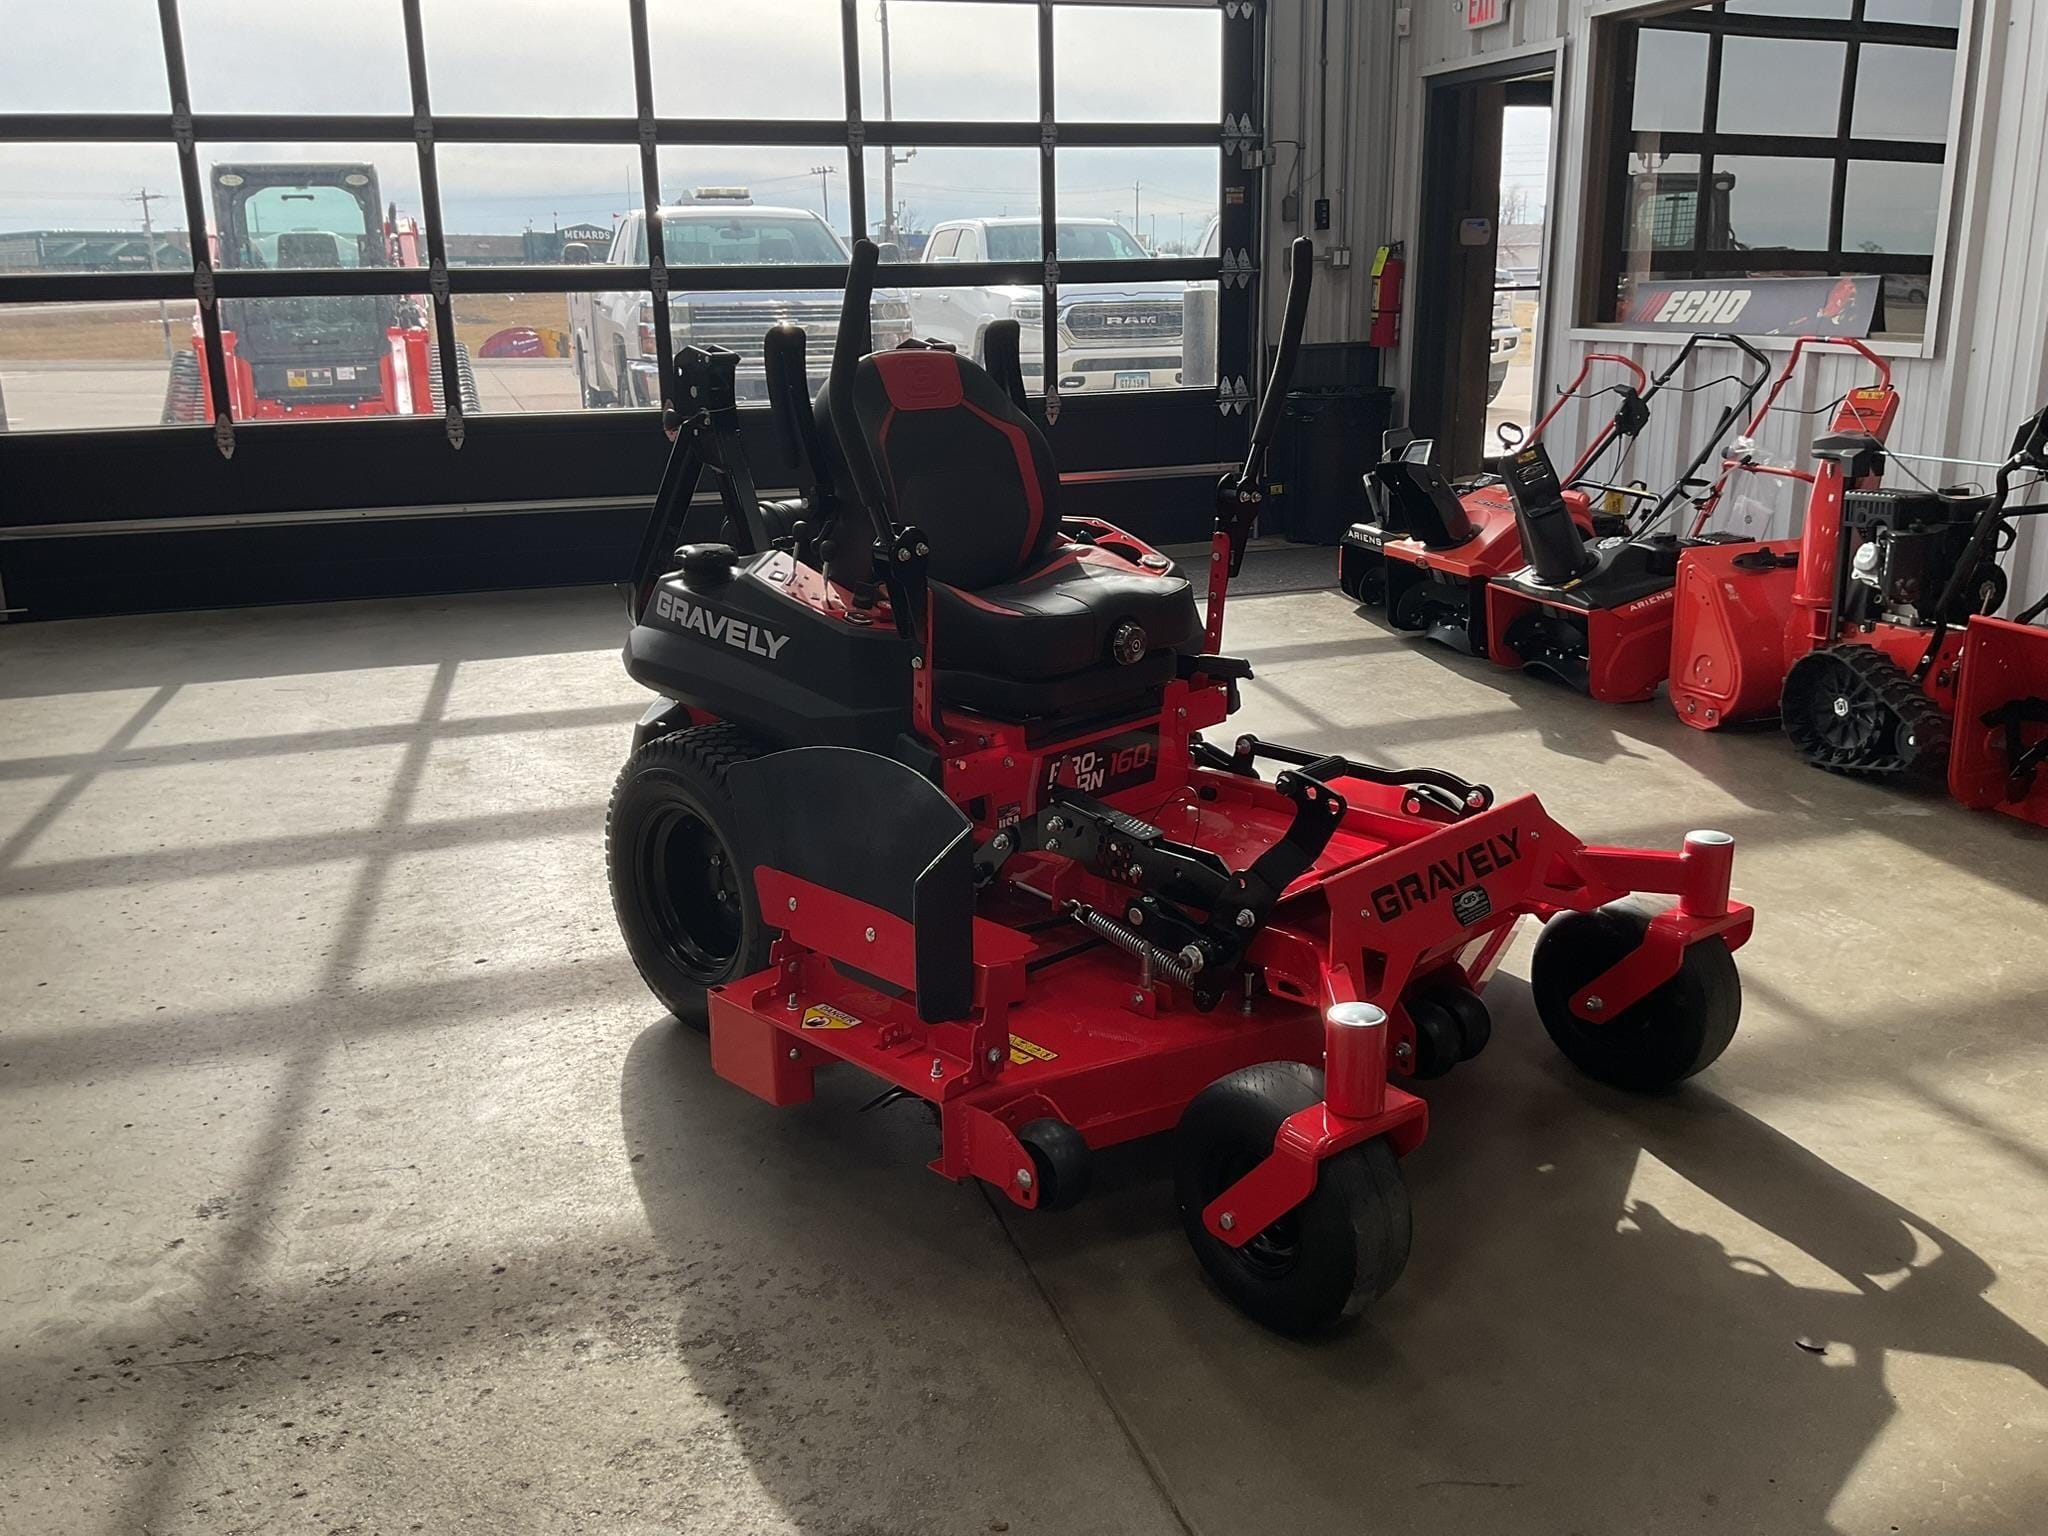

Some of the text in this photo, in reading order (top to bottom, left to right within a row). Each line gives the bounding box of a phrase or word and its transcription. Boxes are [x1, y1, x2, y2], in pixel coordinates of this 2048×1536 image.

[564, 230, 610, 240] MENARDS
[1653, 290, 1752, 324] ECHO
[1106, 315, 1157, 325] RAM
[1347, 529, 1382, 547] ARIENS
[1629, 590, 1673, 612] ARIENS
[656, 590, 791, 660] GRAVELY
[1110, 742, 1152, 776] 160
[1370, 826, 1521, 923] GRAVELY
[820, 1005, 857, 1024] DANGER
